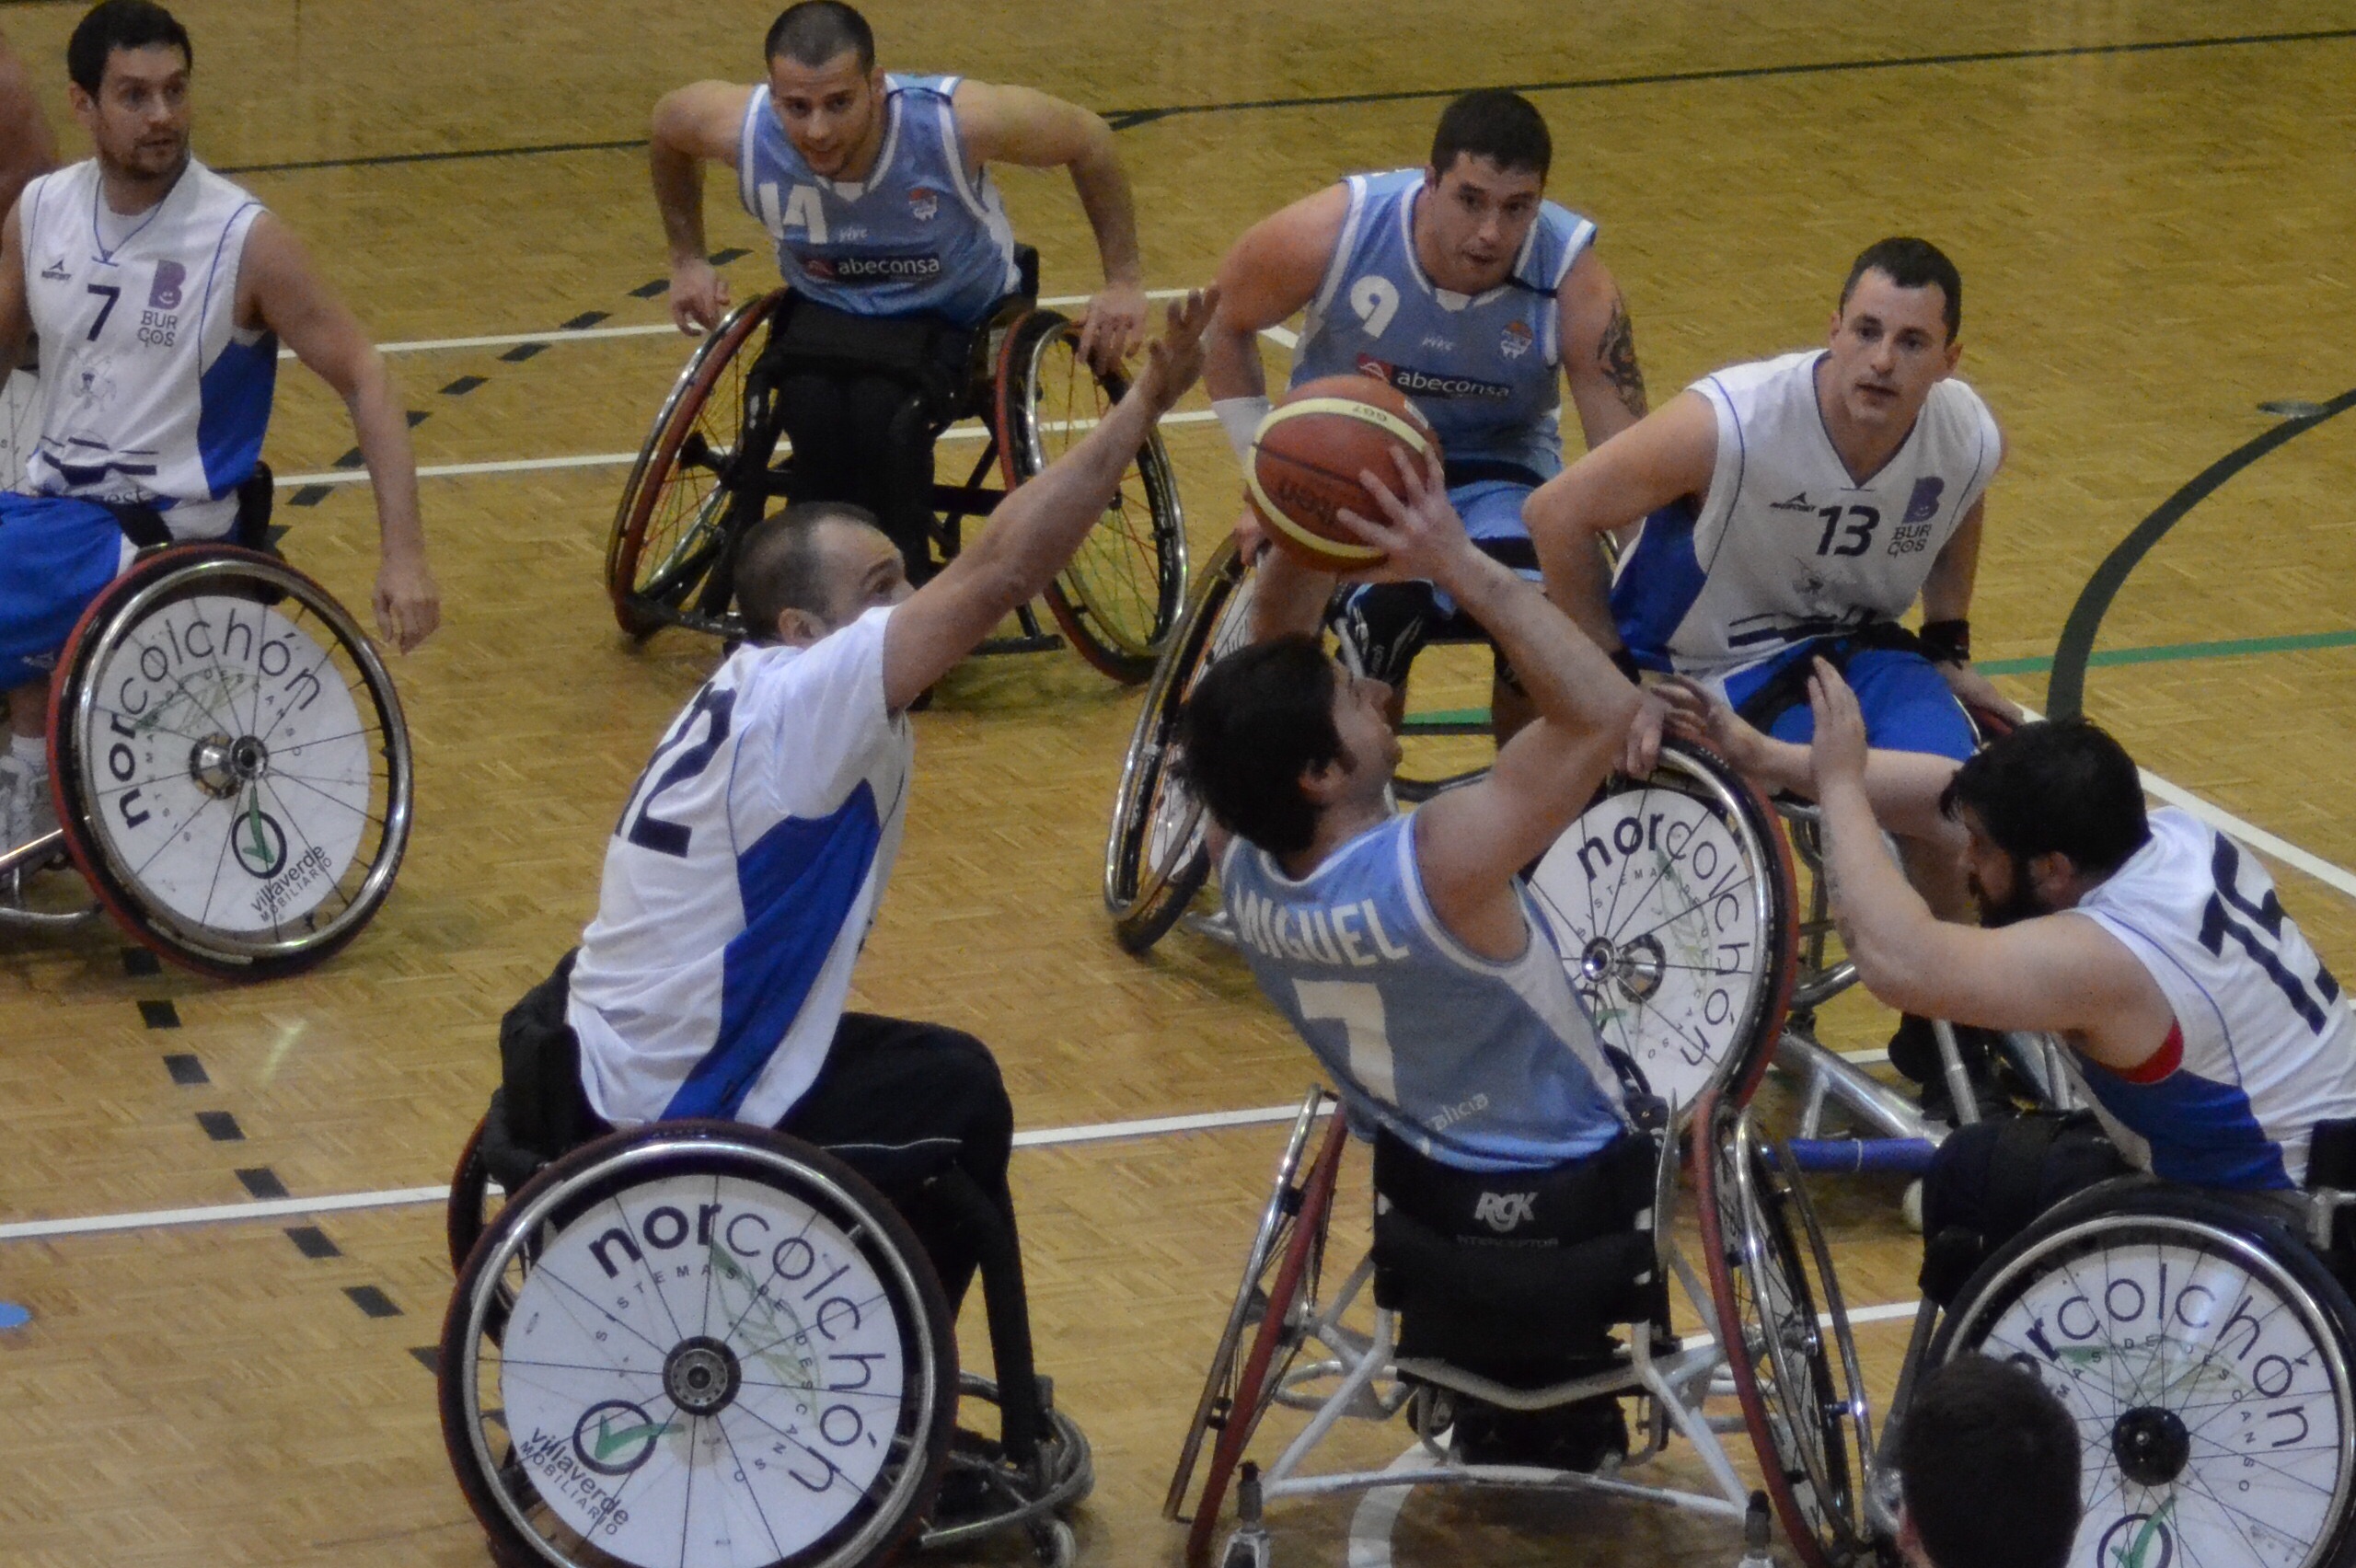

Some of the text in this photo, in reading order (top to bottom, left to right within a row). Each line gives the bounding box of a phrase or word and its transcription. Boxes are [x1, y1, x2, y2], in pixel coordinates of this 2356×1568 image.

[838, 259, 940, 274] abeconsa
[87, 283, 121, 341] 7
[138, 327, 176, 348] GOS
[141, 310, 179, 330] BUR
[1350, 274, 1400, 339] 9
[1397, 371, 1509, 398] abeconsa
[1816, 504, 1880, 557] 13
[1887, 538, 1927, 559] GOS
[1891, 524, 1933, 541] BUR
[109, 608, 320, 829] norcolchón
[250, 846, 326, 912] villaverde
[260, 857, 332, 921] MOBILIARIO
[1234, 882, 1410, 966] MIGUEL
[1576, 813, 1750, 1066] norcolchón
[1291, 977, 1399, 1107] 7
[1425, 1092, 1489, 1133] alicia
[1474, 1192, 1540, 1233] RGK
[589, 1203, 885, 1492] norcolchón
[595, 1264, 742, 1342] SISTEMAS
[733, 1333, 814, 1483] DESCANSO
[2123, 1334, 2159, 1350] DE
[2184, 1343, 2258, 1492] DESCANSO
[520, 1441, 618, 1535] MOBILIARIO
[531, 1426, 629, 1525] villaverde
